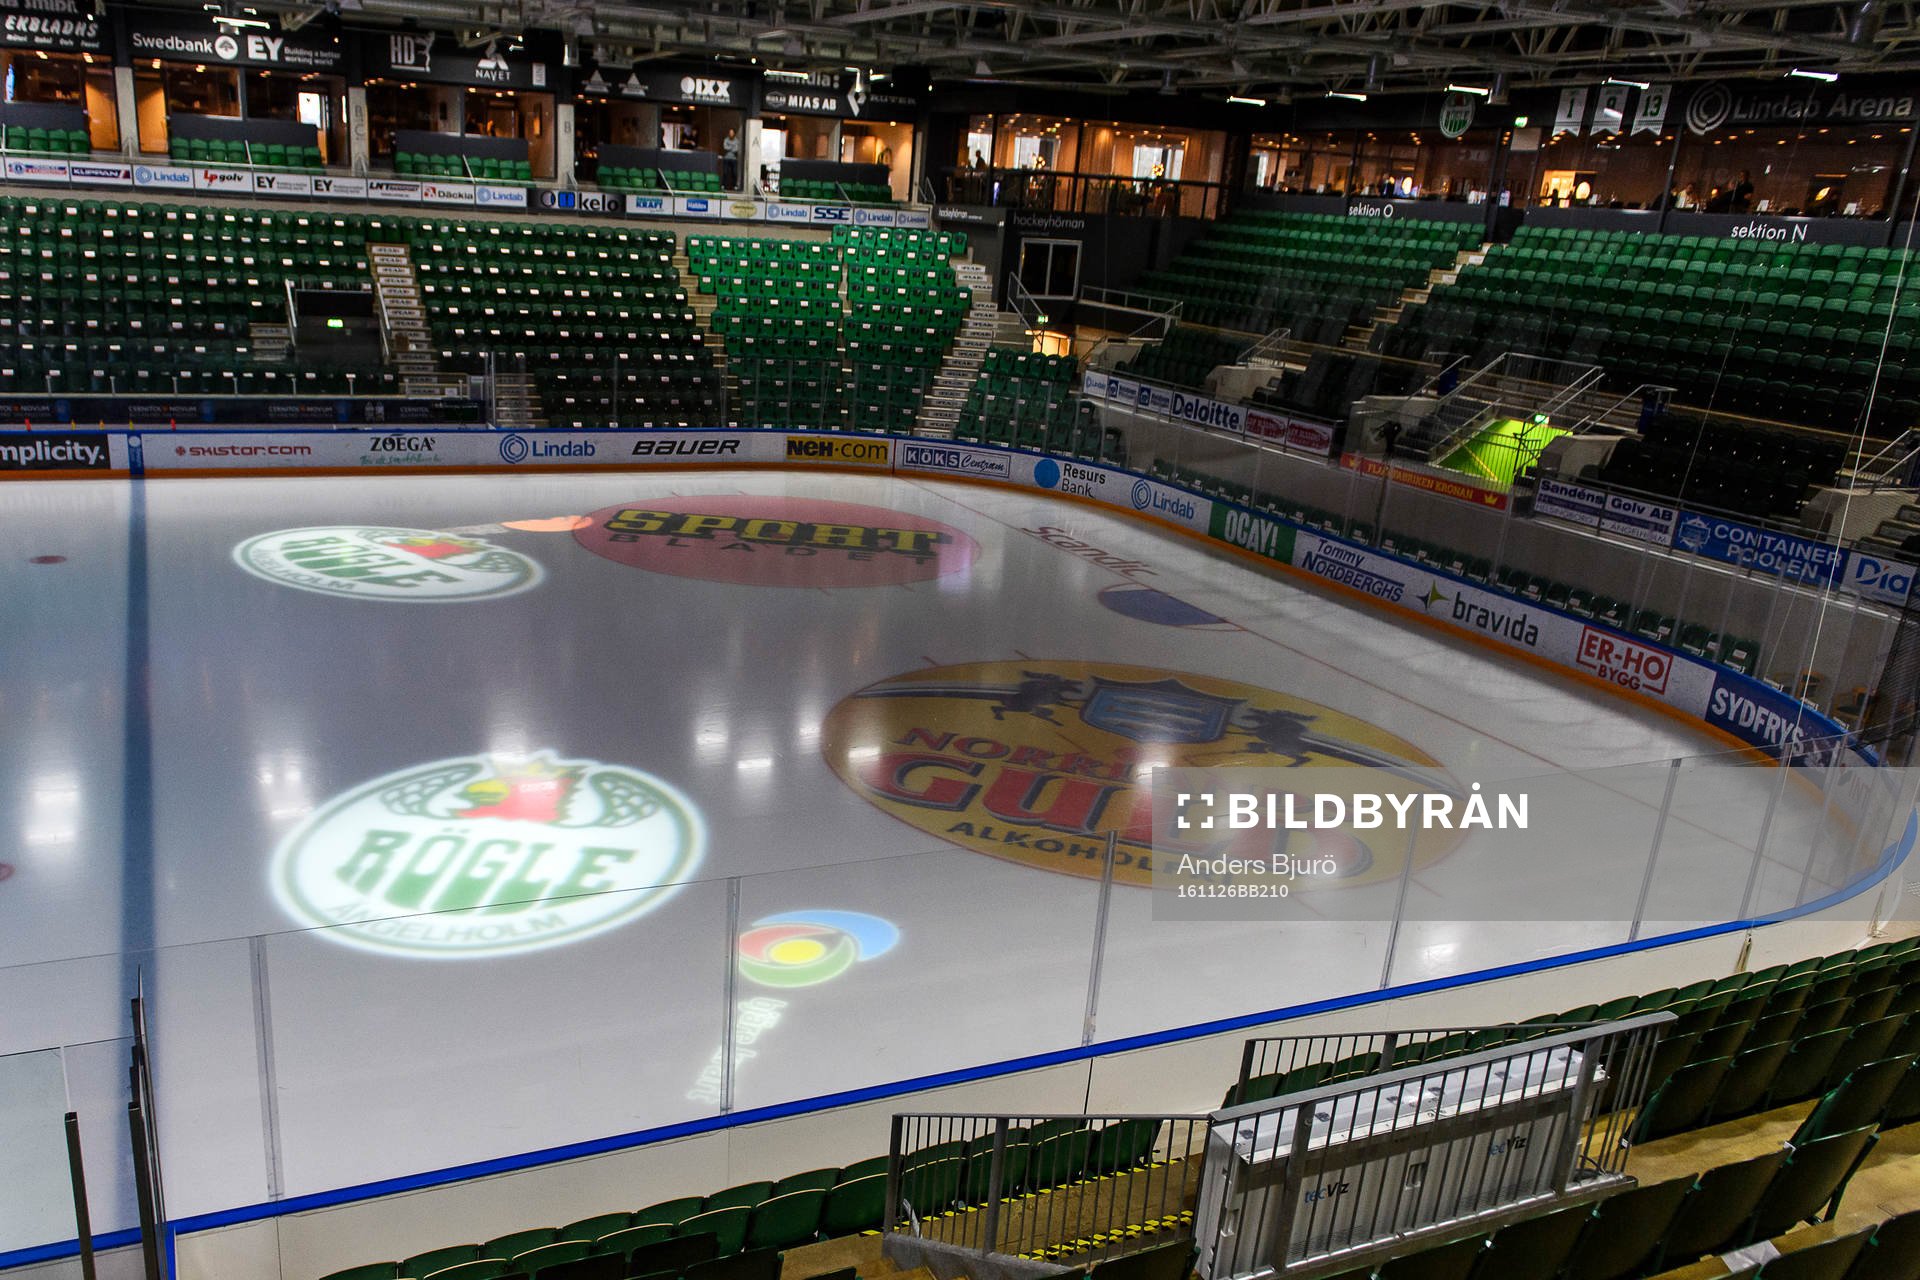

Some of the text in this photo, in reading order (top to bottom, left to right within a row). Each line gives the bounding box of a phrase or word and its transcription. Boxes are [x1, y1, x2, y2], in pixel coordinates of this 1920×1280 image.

[133, 32, 212, 54] Swedbank
[248, 35, 283, 61] EY
[390, 34, 415, 65] HD
[476, 69, 511, 82] NAVET
[788, 94, 820, 110] MIAS
[822, 98, 837, 110] AB
[1732, 92, 1913, 120] Lindab Arena
[153, 171, 190, 184] Lindab
[219, 174, 243, 184] golv
[256, 176, 275, 189] EY
[314, 179, 333, 192] EY
[492, 191, 523, 201] Lindab
[578, 191, 619, 212] kelo
[781, 207, 808, 217] Lindab
[814, 207, 851, 220] SSE
[1349, 203, 1393, 218] sektion O
[1731, 220, 1808, 242] sektion N
[189, 444, 311, 456] skistar.com
[532, 440, 596, 457] Lindab
[906, 446, 1006, 473] KÖKS Centrum
[1063, 463, 1106, 485] Resurs
[1061, 478, 1096, 499] Bank
[1153, 490, 1195, 520] Lindab
[1540, 479, 1673, 522] Sandéns Golv AB
[1224, 510, 1279, 558] OCAY!
[1021, 526, 1160, 577] Scandic
[1317, 538, 1366, 569] Tommy
[1714, 523, 1843, 569] CONTAINER
[1301, 550, 1405, 602] NORDBERGHS
[1451, 591, 1539, 647] bravida
[1583, 633, 1665, 681] ER-HO
[1598, 663, 1641, 691] BYGG
[1711, 686, 1806, 756] SYDFRYS
[336, 826, 639, 918] RÖGLE
